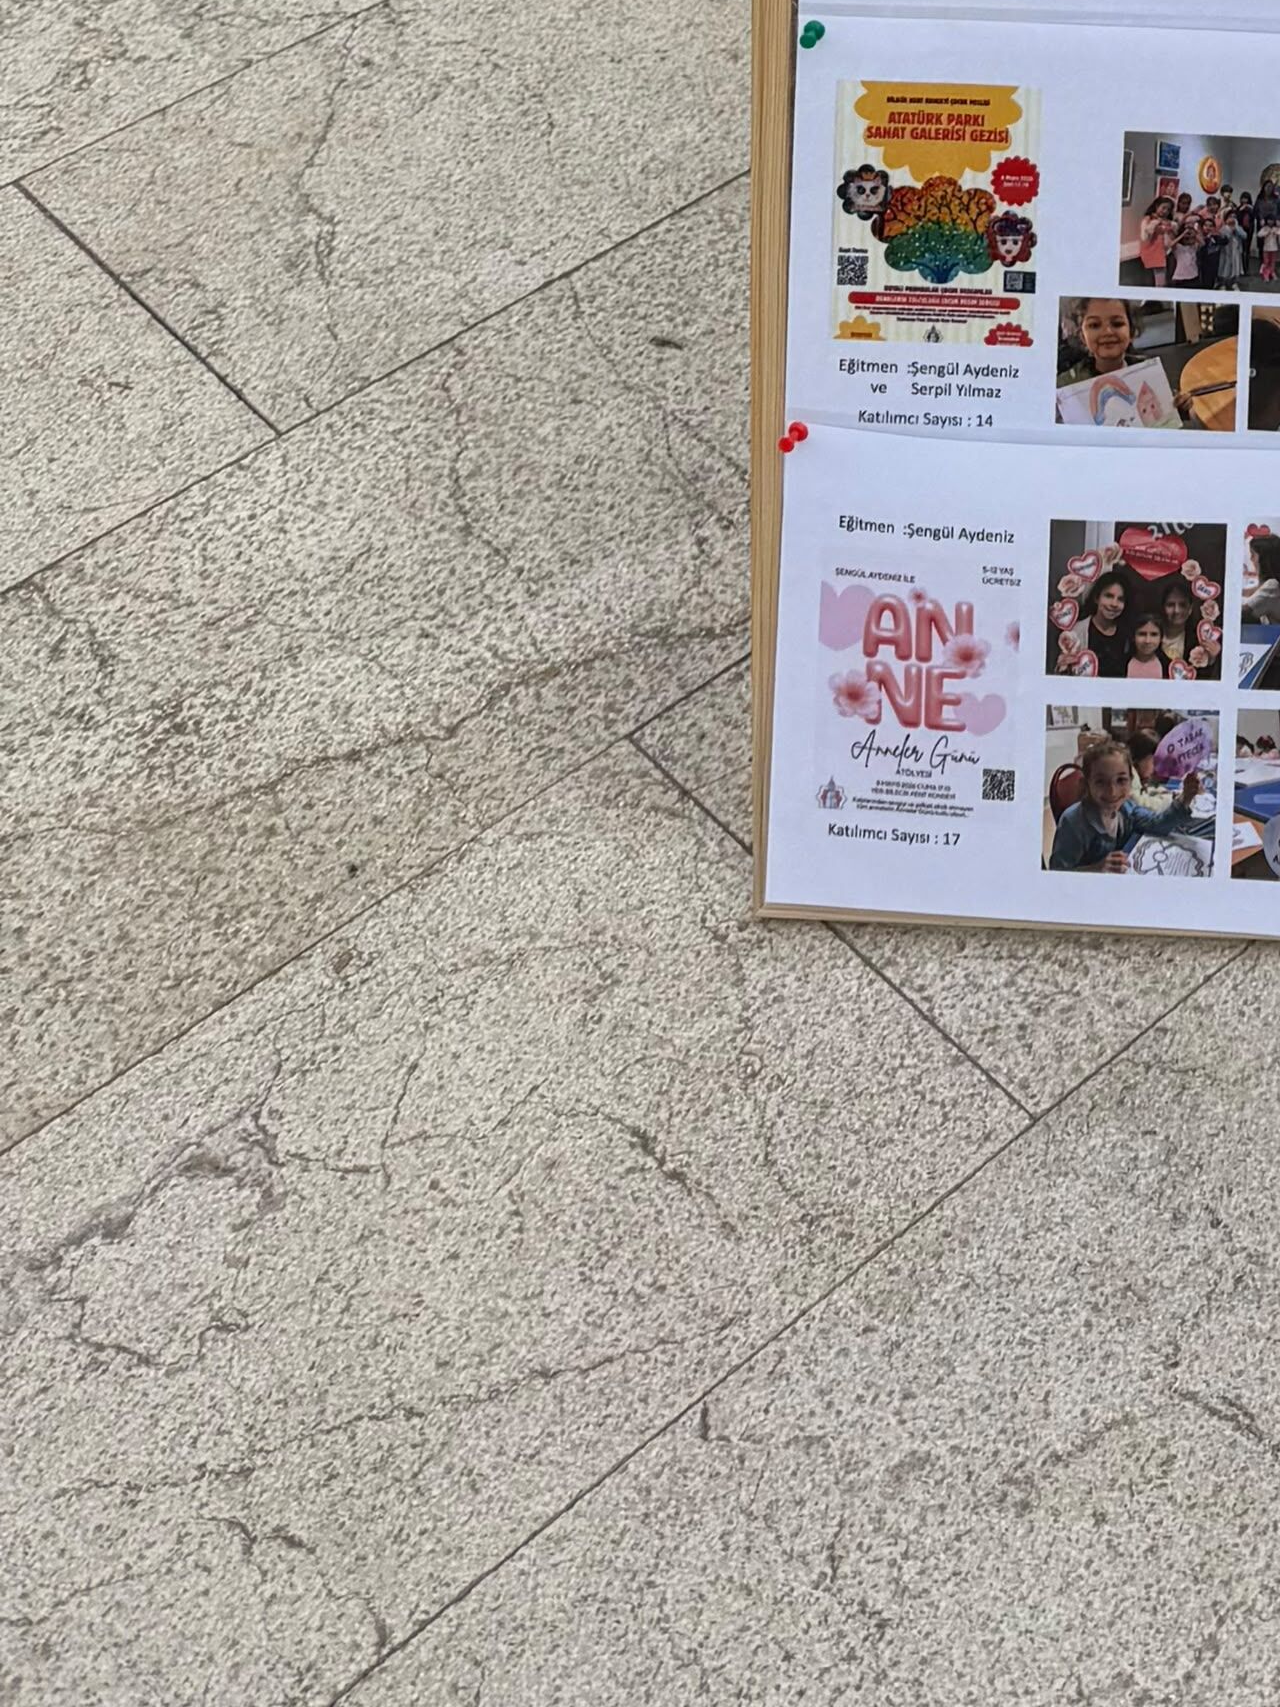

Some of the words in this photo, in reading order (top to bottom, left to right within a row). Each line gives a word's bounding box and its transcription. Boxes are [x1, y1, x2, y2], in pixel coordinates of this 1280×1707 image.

[888, 110, 943, 125] ATATÜRK
[947, 113, 985, 127] PARKI
[866, 126, 906, 139] SANAT
[910, 126, 966, 141] GALERİSİ
[970, 127, 1009, 144] GEZİSİ
[839, 359, 898, 375] Eğitmen
[963, 363, 1019, 379] Aydeniz
[870, 384, 887, 394] ve
[911, 383, 951, 398] Serpil
[956, 384, 1001, 398] Yılmaz
[858, 410, 919, 424] Katılımcı
[923, 413, 962, 429] Sayısı
[976, 415, 993, 427] 14
[839, 515, 895, 533] Eğitmen
[958, 528, 1014, 544] Aydeniz
[863, 593, 974, 664] AN
[865, 660, 966, 732] NE
[851, 729, 923, 768] Anneler
[929, 735, 980, 775] Günü
[828, 823, 887, 840] Katılımcı
[891, 828, 930, 845] Sayısı
[943, 833, 960, 846] 17
